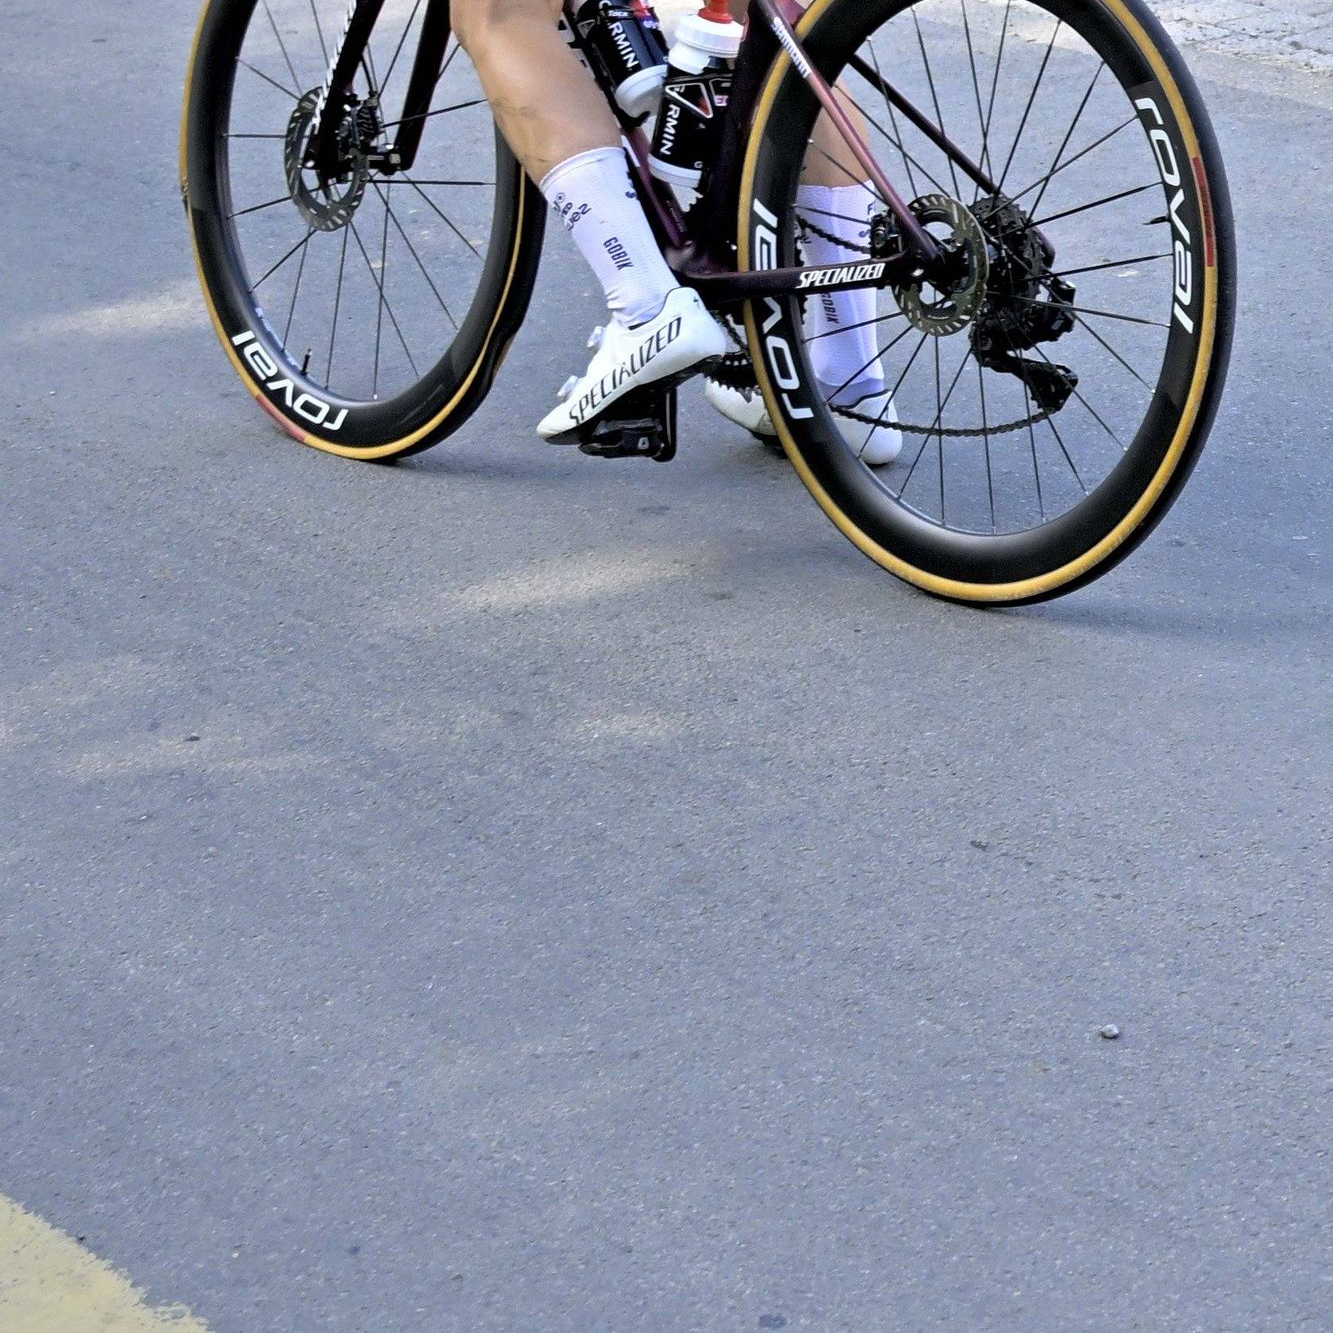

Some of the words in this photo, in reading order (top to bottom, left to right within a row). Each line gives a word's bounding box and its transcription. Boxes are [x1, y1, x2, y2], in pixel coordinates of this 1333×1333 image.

[603, 236, 634, 270] GOBIK
[795, 262, 886, 289] SPECIALIZED
[568, 316, 682, 426] SPECIALIZED
